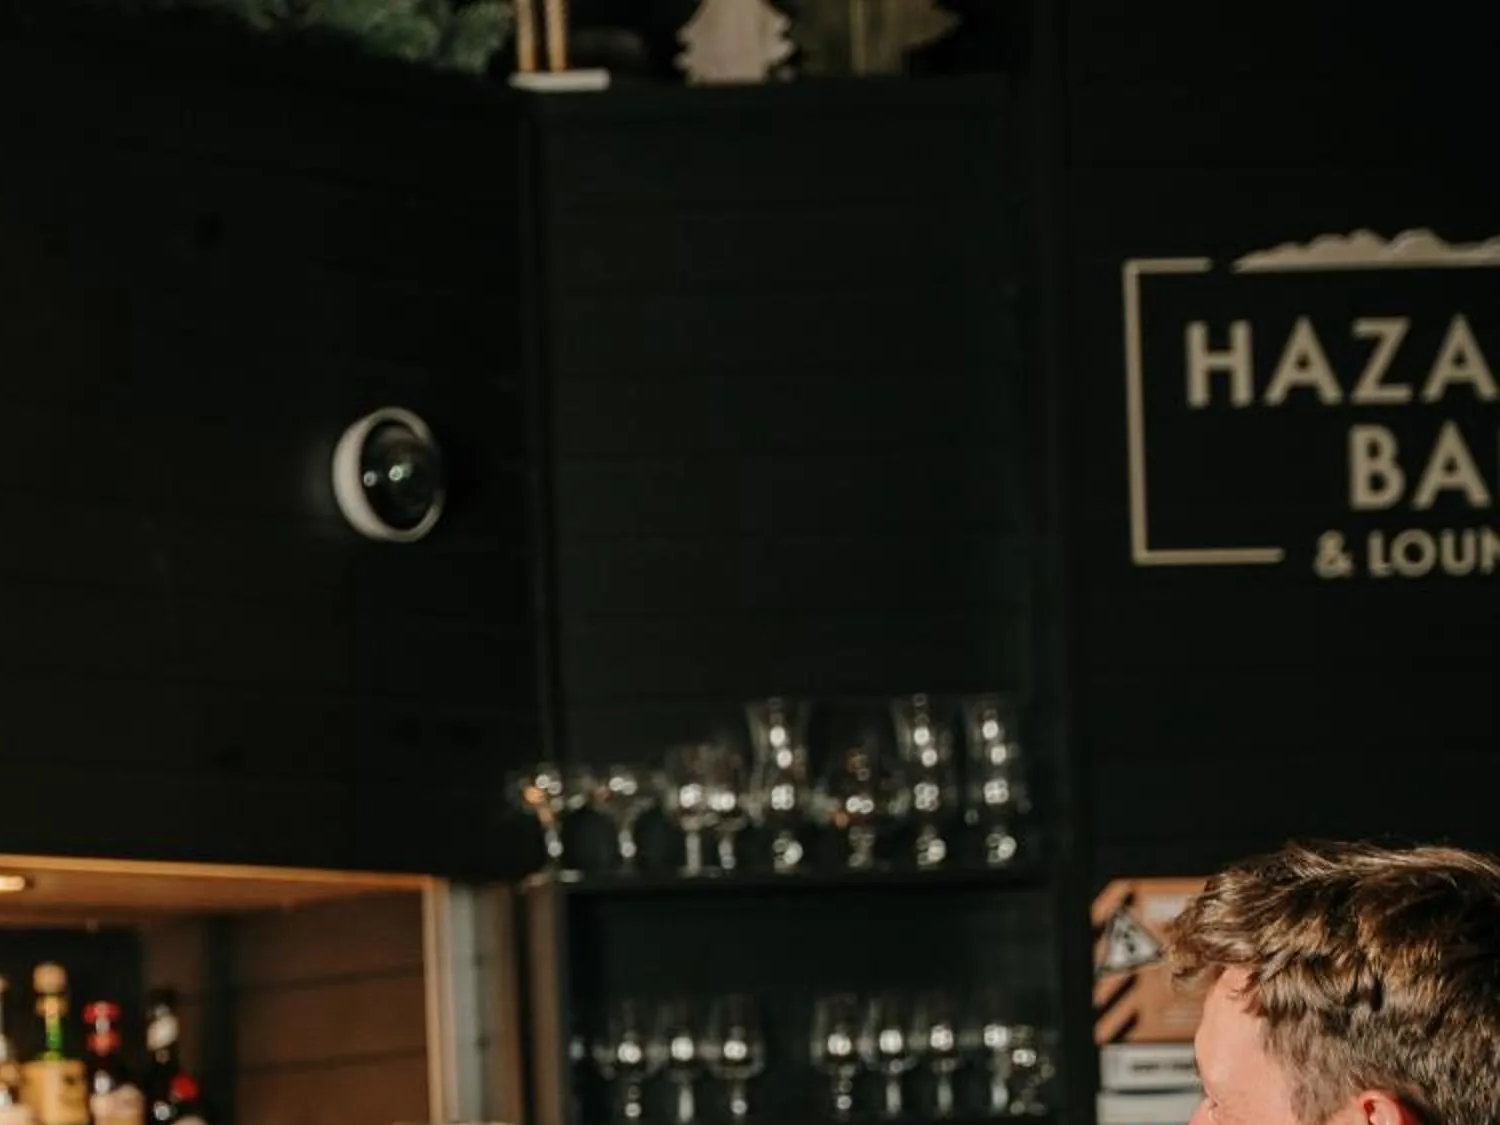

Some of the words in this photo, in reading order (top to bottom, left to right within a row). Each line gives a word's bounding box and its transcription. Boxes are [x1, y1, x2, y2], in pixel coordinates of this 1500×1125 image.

[1185, 313, 1500, 408] HAZA
[1348, 420, 1500, 511] BA
[1312, 530, 1354, 578] &
